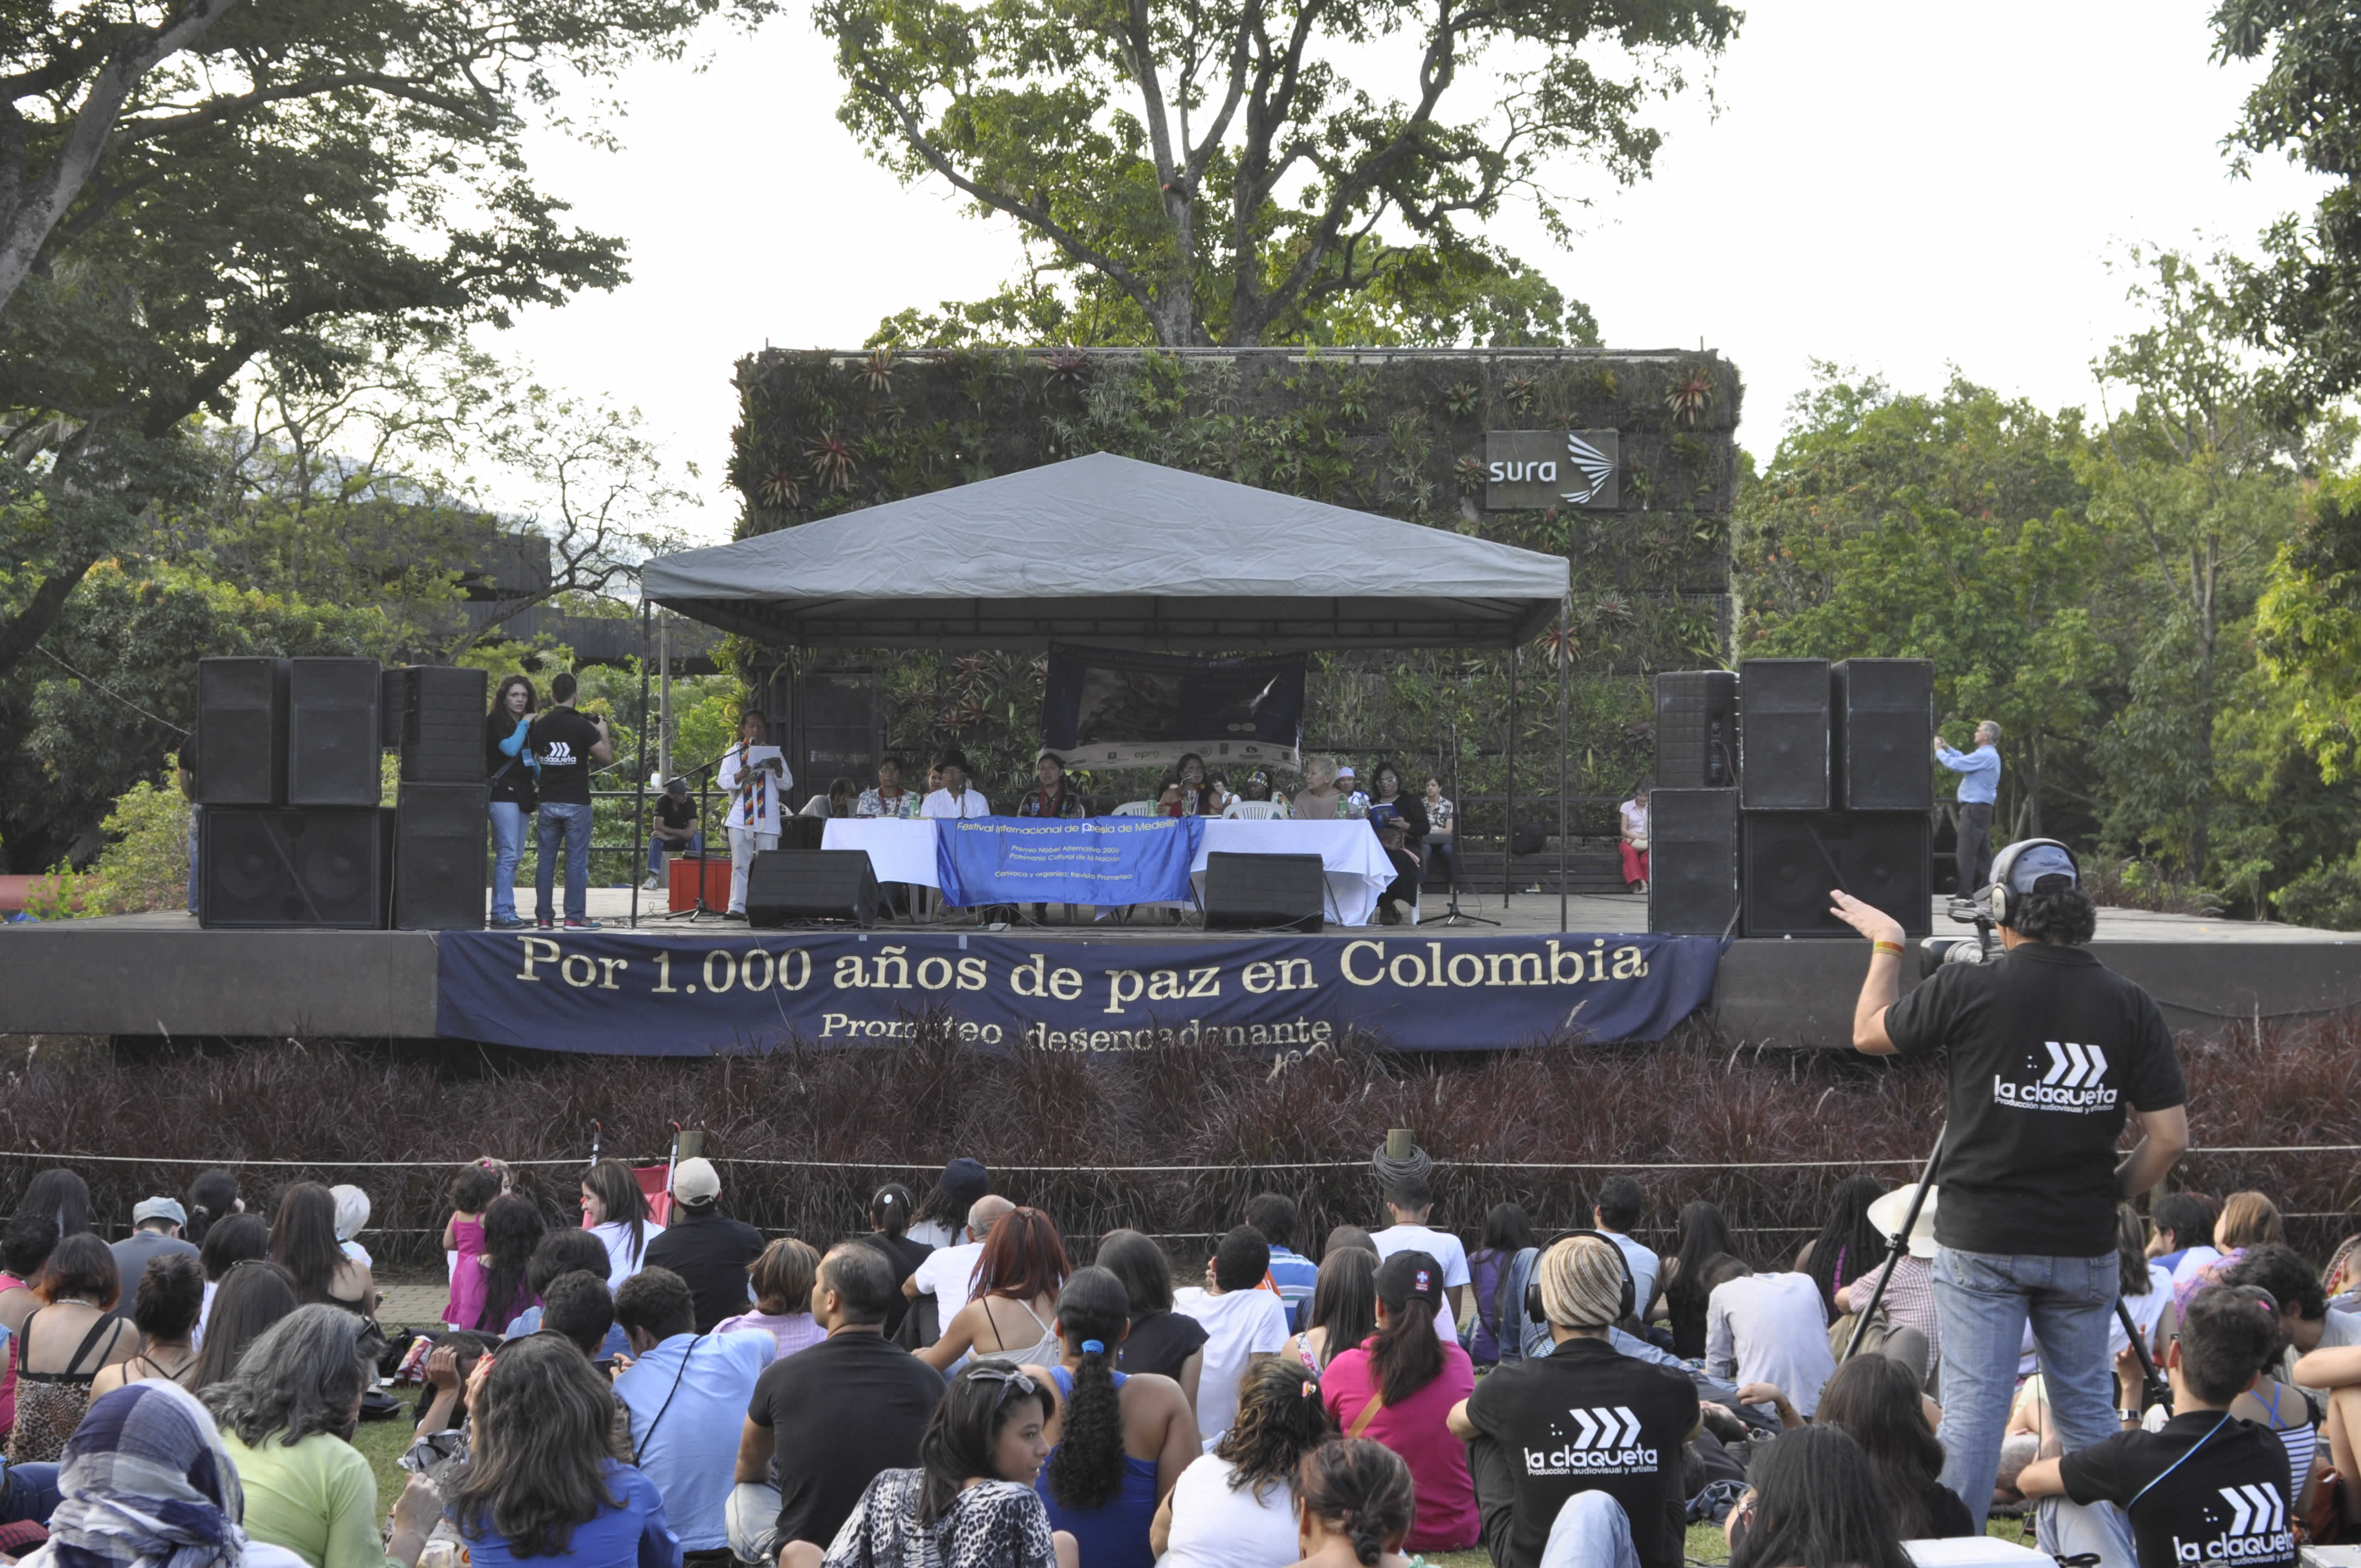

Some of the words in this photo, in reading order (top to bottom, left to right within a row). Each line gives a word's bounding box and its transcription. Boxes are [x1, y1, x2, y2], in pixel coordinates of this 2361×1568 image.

[1489, 461, 1557, 482] sura
[956, 823, 994, 832] Festival
[995, 824, 1062, 835] Internacional
[1118, 824, 1133, 832] de
[1009, 853, 1047, 862] Patrimonio
[1011, 845, 1037, 853] Premio
[1062, 845, 1101, 853] Alternativo
[1035, 870, 1069, 879] organiza:
[1070, 871, 1096, 880] Revista
[516, 935, 628, 990] Por
[651, 948, 812, 994] 1.000
[833, 945, 987, 990] años
[1010, 954, 1083, 1000] de
[1103, 966, 1221, 1014] paz
[1242, 958, 1319, 994] en
[1340, 938, 1649, 987] Colombia
[819, 1014, 1003, 1044] Promteo
[1994, 1074, 2016, 1098] la
[2021, 1079, 2118, 1105] claqueta
[1994, 1097, 2038, 1109] Producción
[2040, 1103, 2083, 1113] audiovisual
[2085, 1106, 2090, 1115] y
[1524, 1447, 1544, 1468] la
[1550, 1443, 1658, 1467] claqueta
[1527, 1466, 1570, 1476] Producción
[1573, 1466, 1622, 1474] audiovisual
[2173, 1536, 2201, 1561] la
[2231, 1553, 2275, 1566] audiovisual
[2276, 1554, 2281, 1562] y
